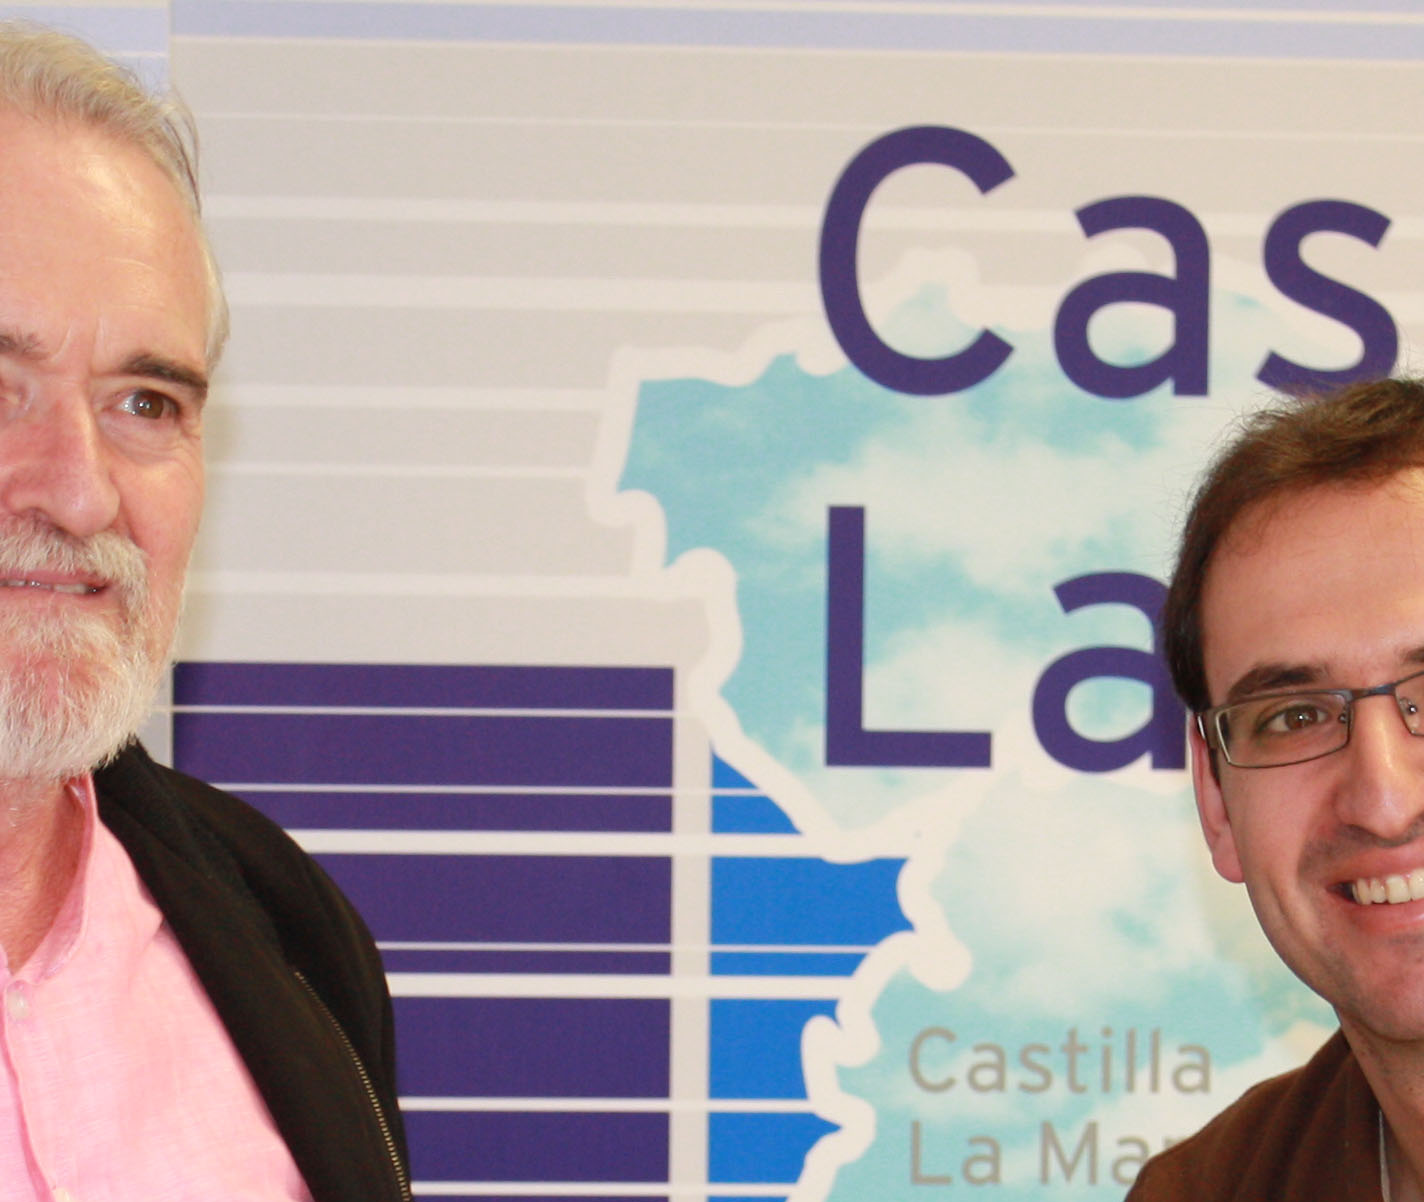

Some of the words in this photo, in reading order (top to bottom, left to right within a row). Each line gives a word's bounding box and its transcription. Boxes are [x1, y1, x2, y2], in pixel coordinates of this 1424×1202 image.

[824, 505, 1187, 773] La
[907, 1026, 1213, 1094] Castilla
[909, 1120, 1002, 1186] La
[1039, 1120, 1194, 1187] Ma
